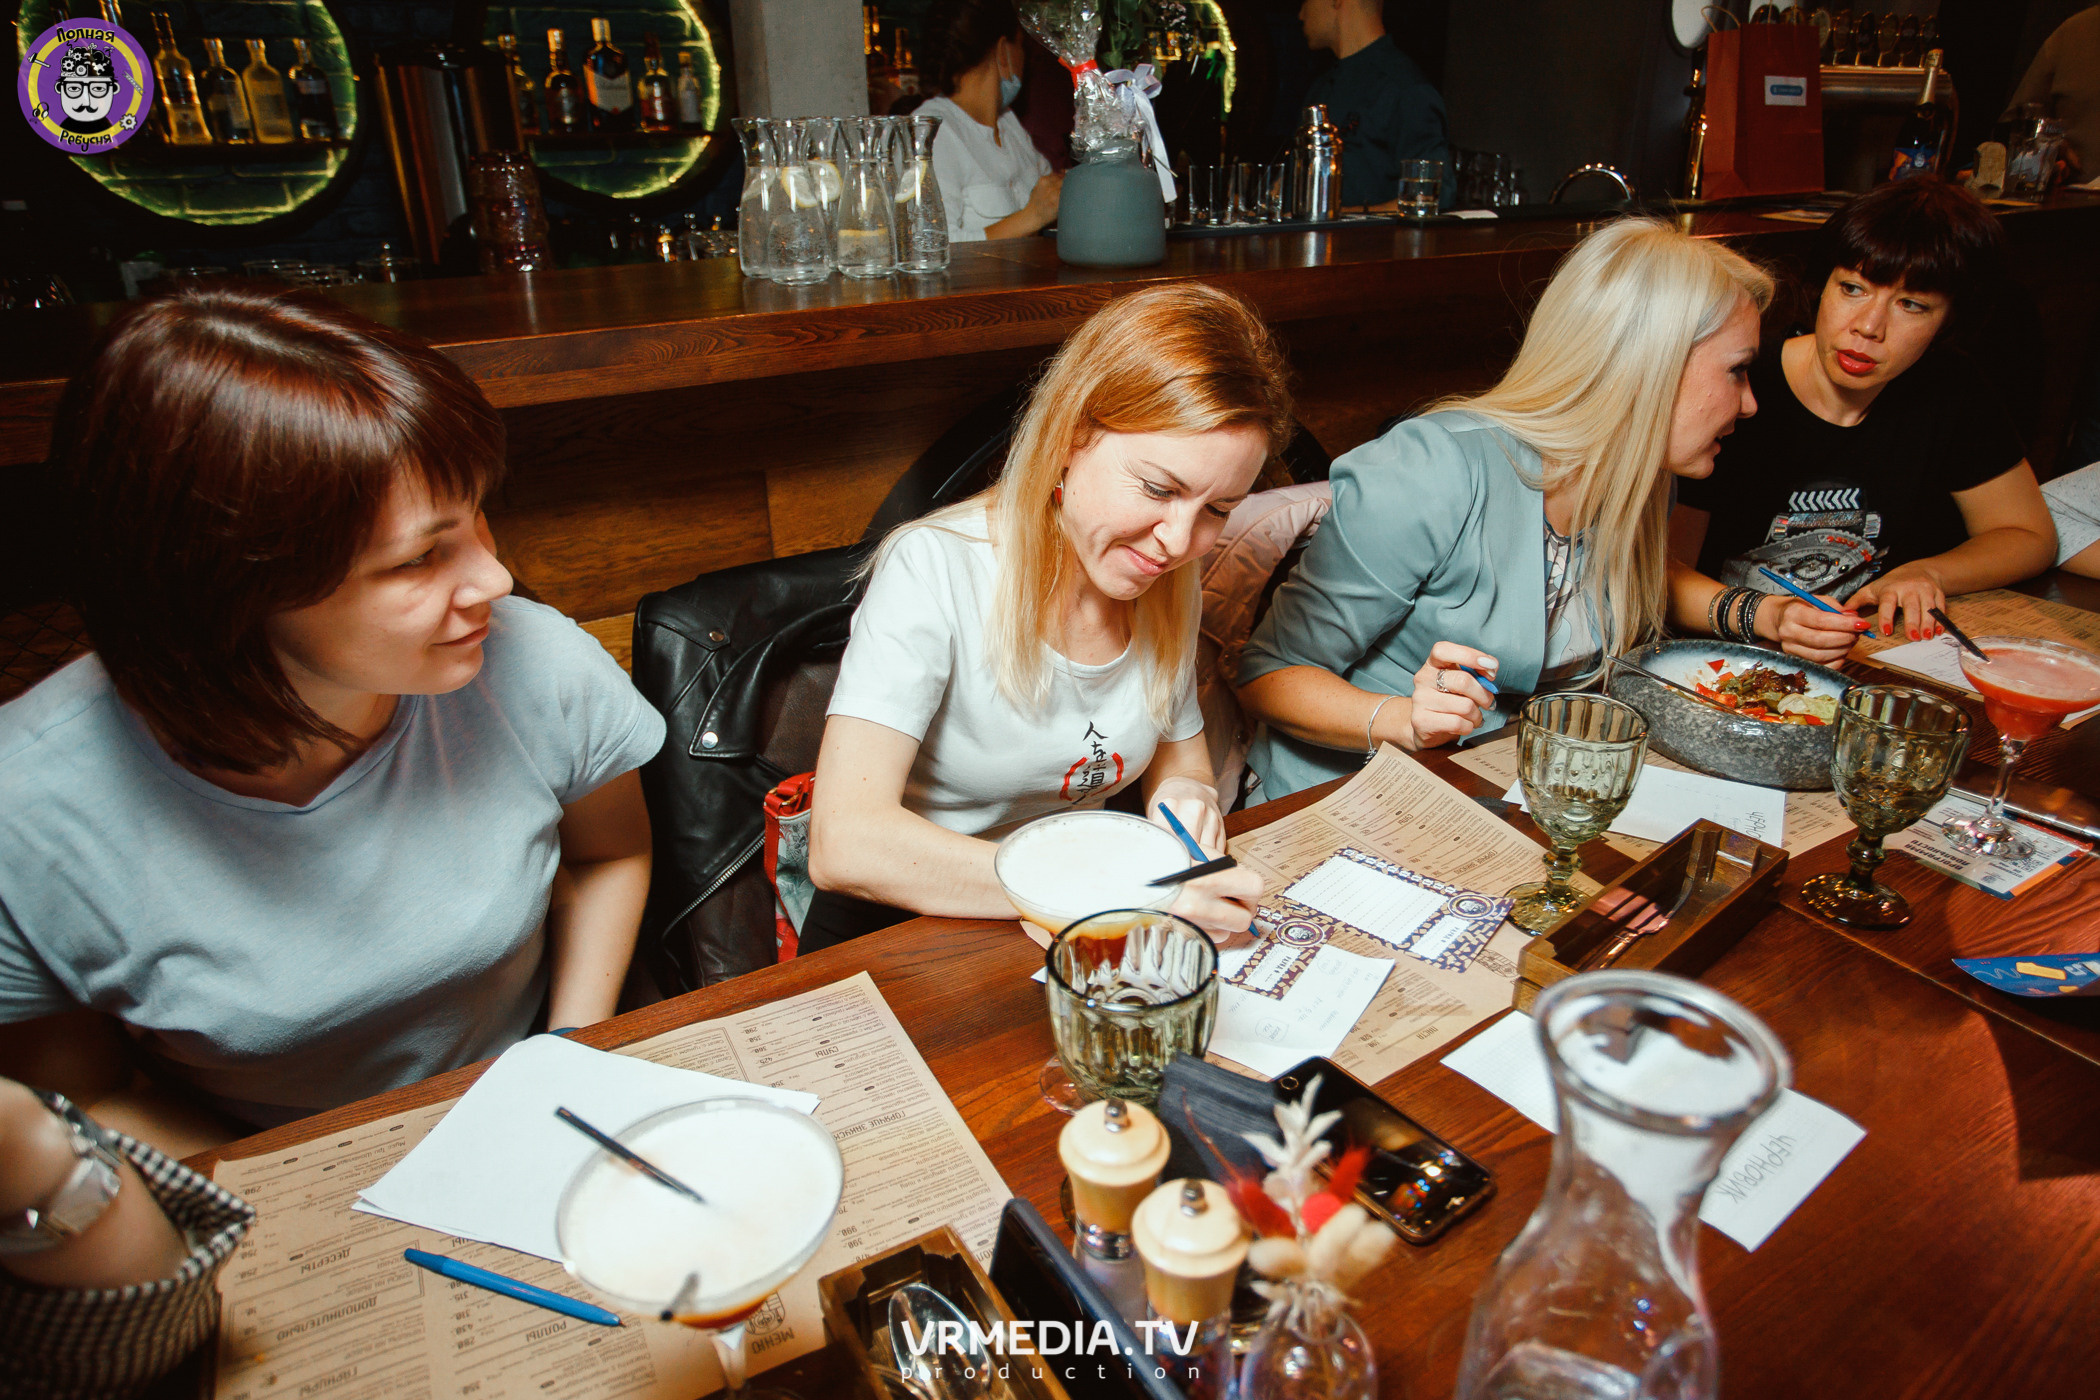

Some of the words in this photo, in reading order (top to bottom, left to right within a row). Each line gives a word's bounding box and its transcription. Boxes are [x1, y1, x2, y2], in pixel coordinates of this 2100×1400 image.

[1396, 812, 1413, 826] СУПЫ
[1903, 842, 1964, 870] ПРОГРАММА
[1909, 838, 1971, 866] ЛОЯЛЬНОСТИ
[1414, 1024, 1439, 1041] ПАСТА
[813, 1043, 839, 1059] СУПЫ
[831, 1122, 868, 1141] ЗАКУСК
[867, 1108, 906, 1128] ГОРЯЧИЕ
[1714, 1134, 1797, 1204] ЧЕРНОВИК
[299, 1246, 350, 1275] ДЕСЕРТЫ
[273, 1294, 380, 1341] ДОПОЛНИТЕЛЬНО
[523, 1319, 568, 1343] РОЛЛЫ
[749, 1326, 795, 1355] МЕНЮ
[297, 1365, 357, 1397] ГАРНИРЫ
